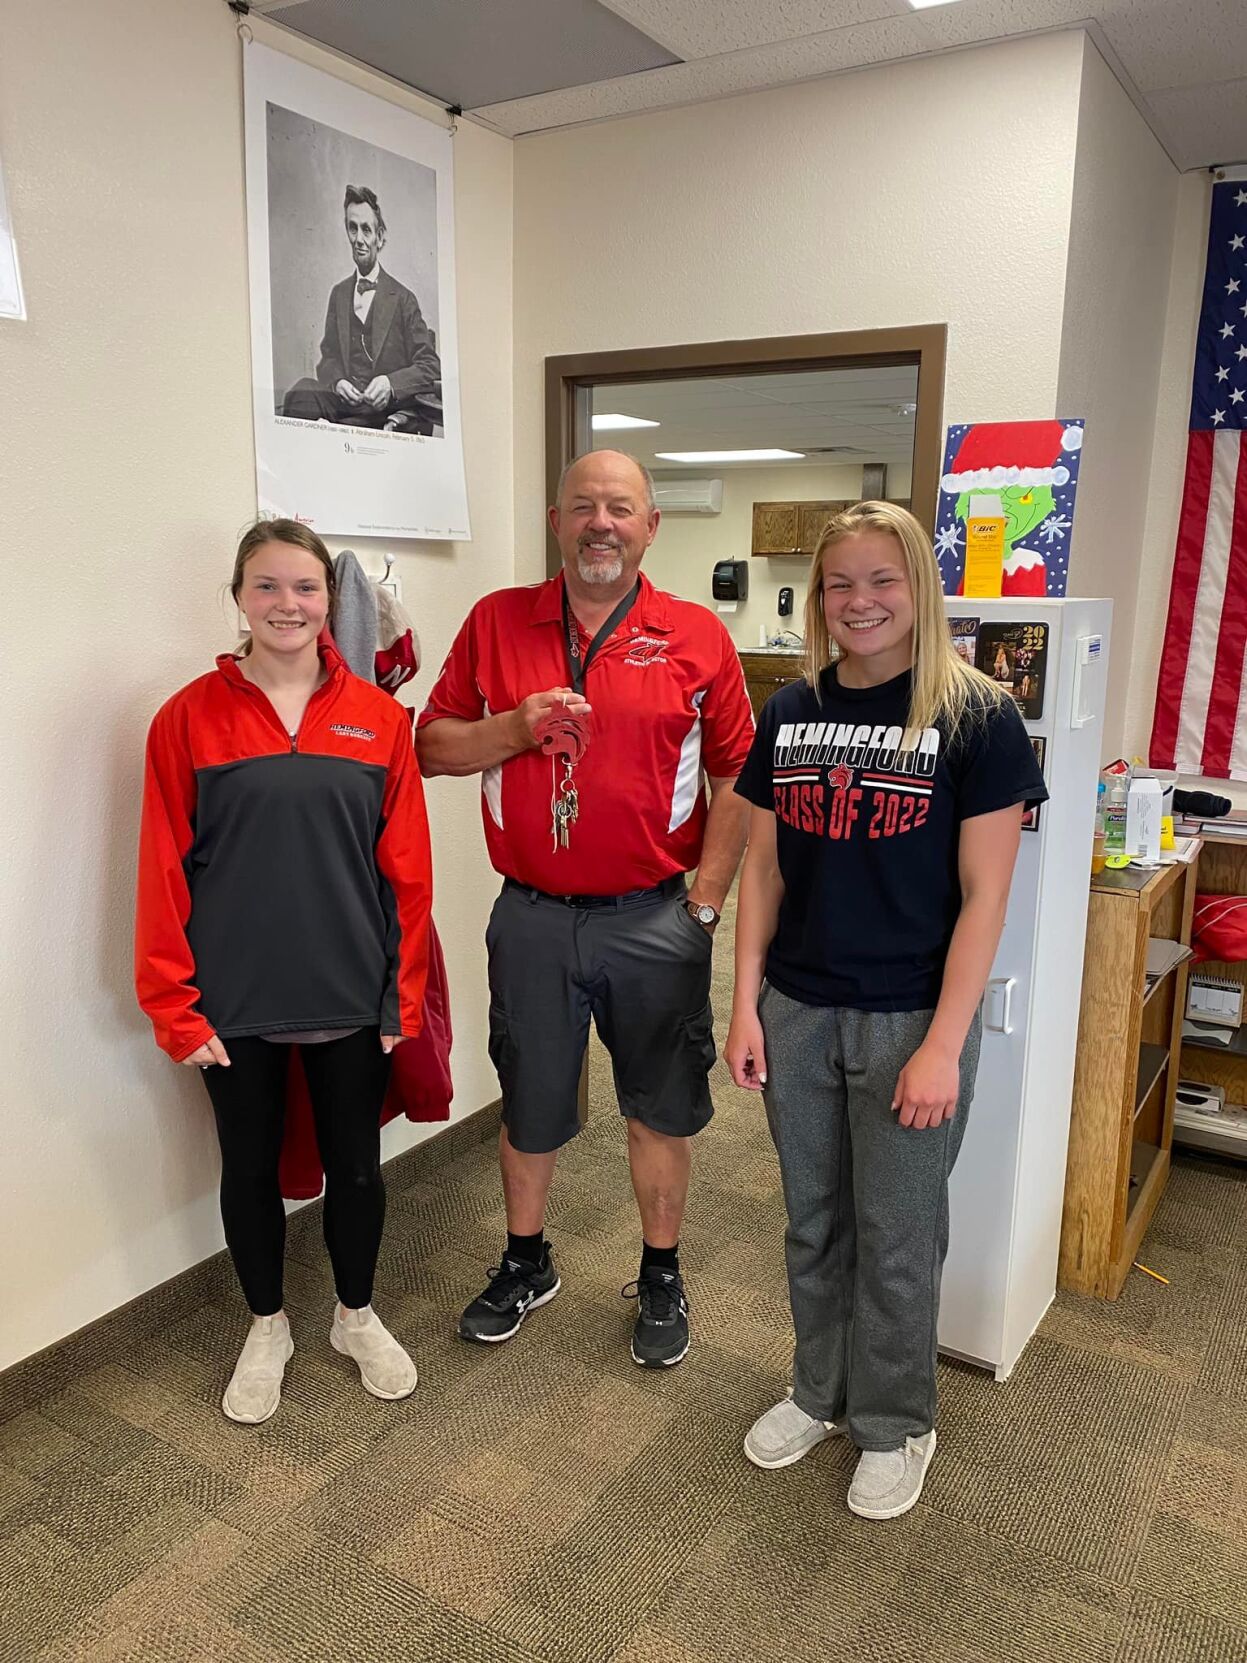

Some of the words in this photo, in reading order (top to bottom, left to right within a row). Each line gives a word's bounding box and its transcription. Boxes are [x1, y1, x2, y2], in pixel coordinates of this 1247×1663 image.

[1022, 625, 1045, 638] 20
[1022, 638, 1044, 651] 22
[380, 664, 411, 688] N
[773, 722, 941, 777] HEMINGFORD
[773, 784, 825, 837] CLASS
[828, 787, 863, 840] OF
[868, 791, 930, 839] 2022
